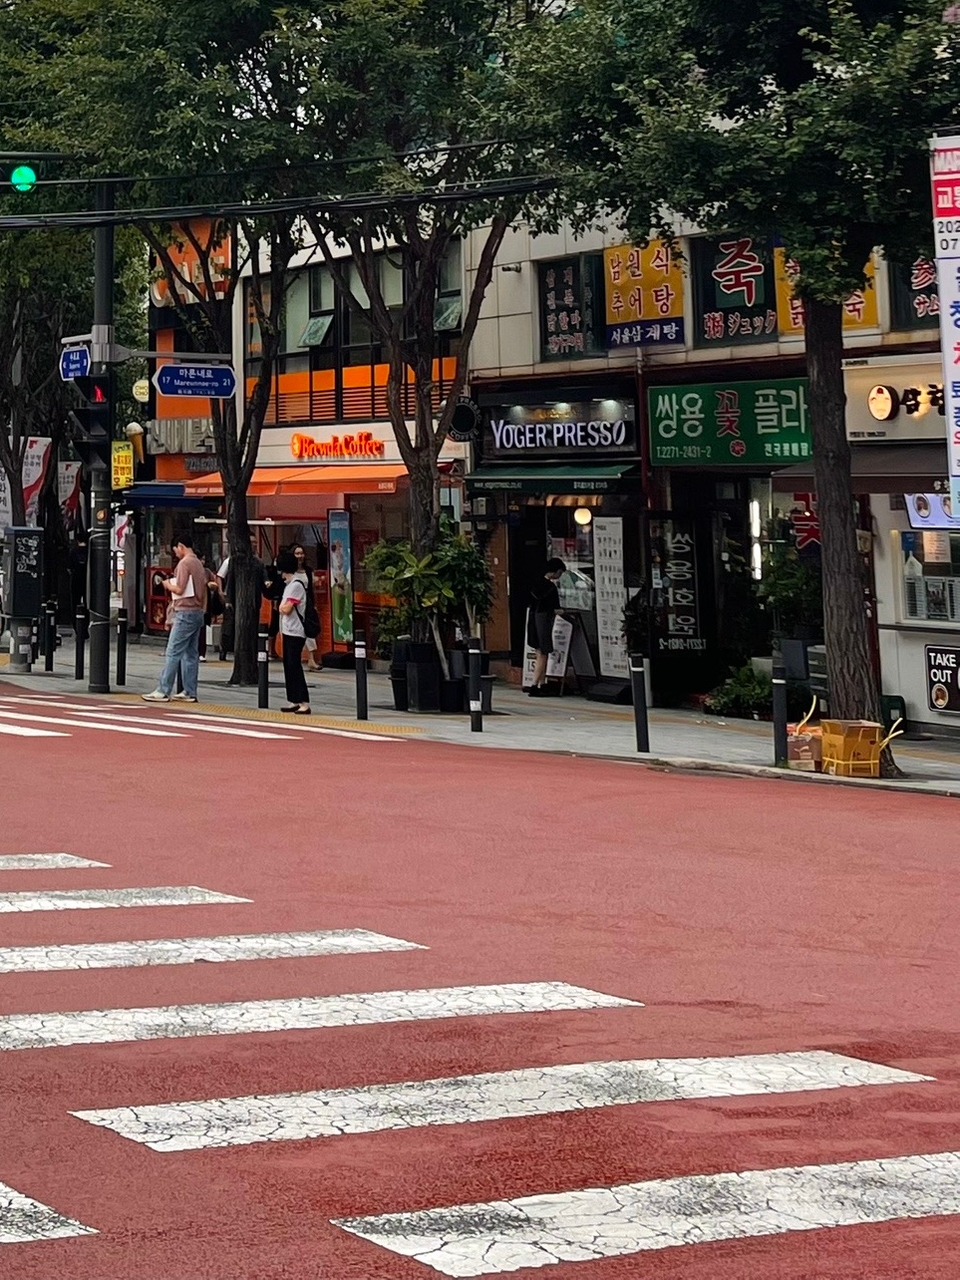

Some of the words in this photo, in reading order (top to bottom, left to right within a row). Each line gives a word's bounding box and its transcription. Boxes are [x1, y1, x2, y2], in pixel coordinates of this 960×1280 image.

[713, 238, 764, 307] 죽
[611, 285, 675, 318] 추어탕
[162, 376, 171, 384] 17
[179, 369, 214, 378] 마른내로
[222, 378, 231, 386] 21
[656, 393, 705, 438] 쌍용
[714, 389, 740, 437] 꽃
[343, 432, 384, 456] Coffee
[491, 420, 547, 449] YOGER
[553, 420, 626, 447] PRESSO
[929, 652, 957, 667] TAKE
[930, 669, 952, 683] OUT
